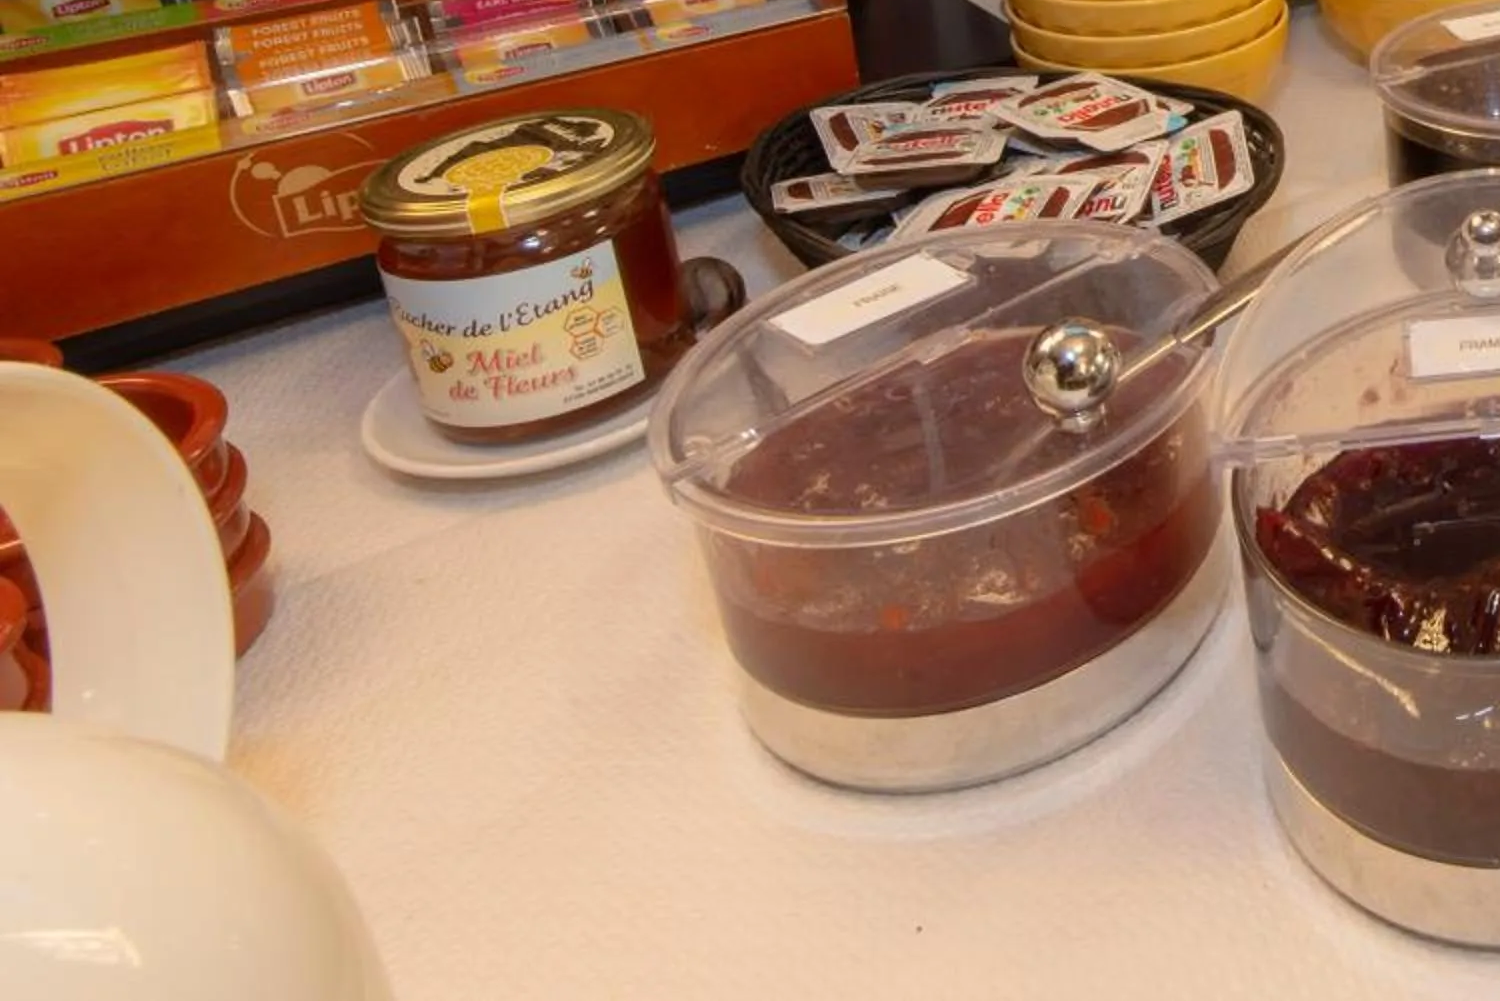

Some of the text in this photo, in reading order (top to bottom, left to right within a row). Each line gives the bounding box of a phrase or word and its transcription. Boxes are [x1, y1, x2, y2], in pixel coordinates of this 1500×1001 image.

[252, 8, 362, 37] FOREST FRUITS
[252, 22, 364, 50] FOREST FRUITS
[258, 35, 370, 69] FOREST FRUITS
[304, 74, 353, 95] Lipton
[292, 189, 360, 225] Lip
[462, 318, 493, 338] de
[466, 342, 543, 375] Miel
[448, 380, 479, 401] de
[482, 364, 577, 399] Fleurs
